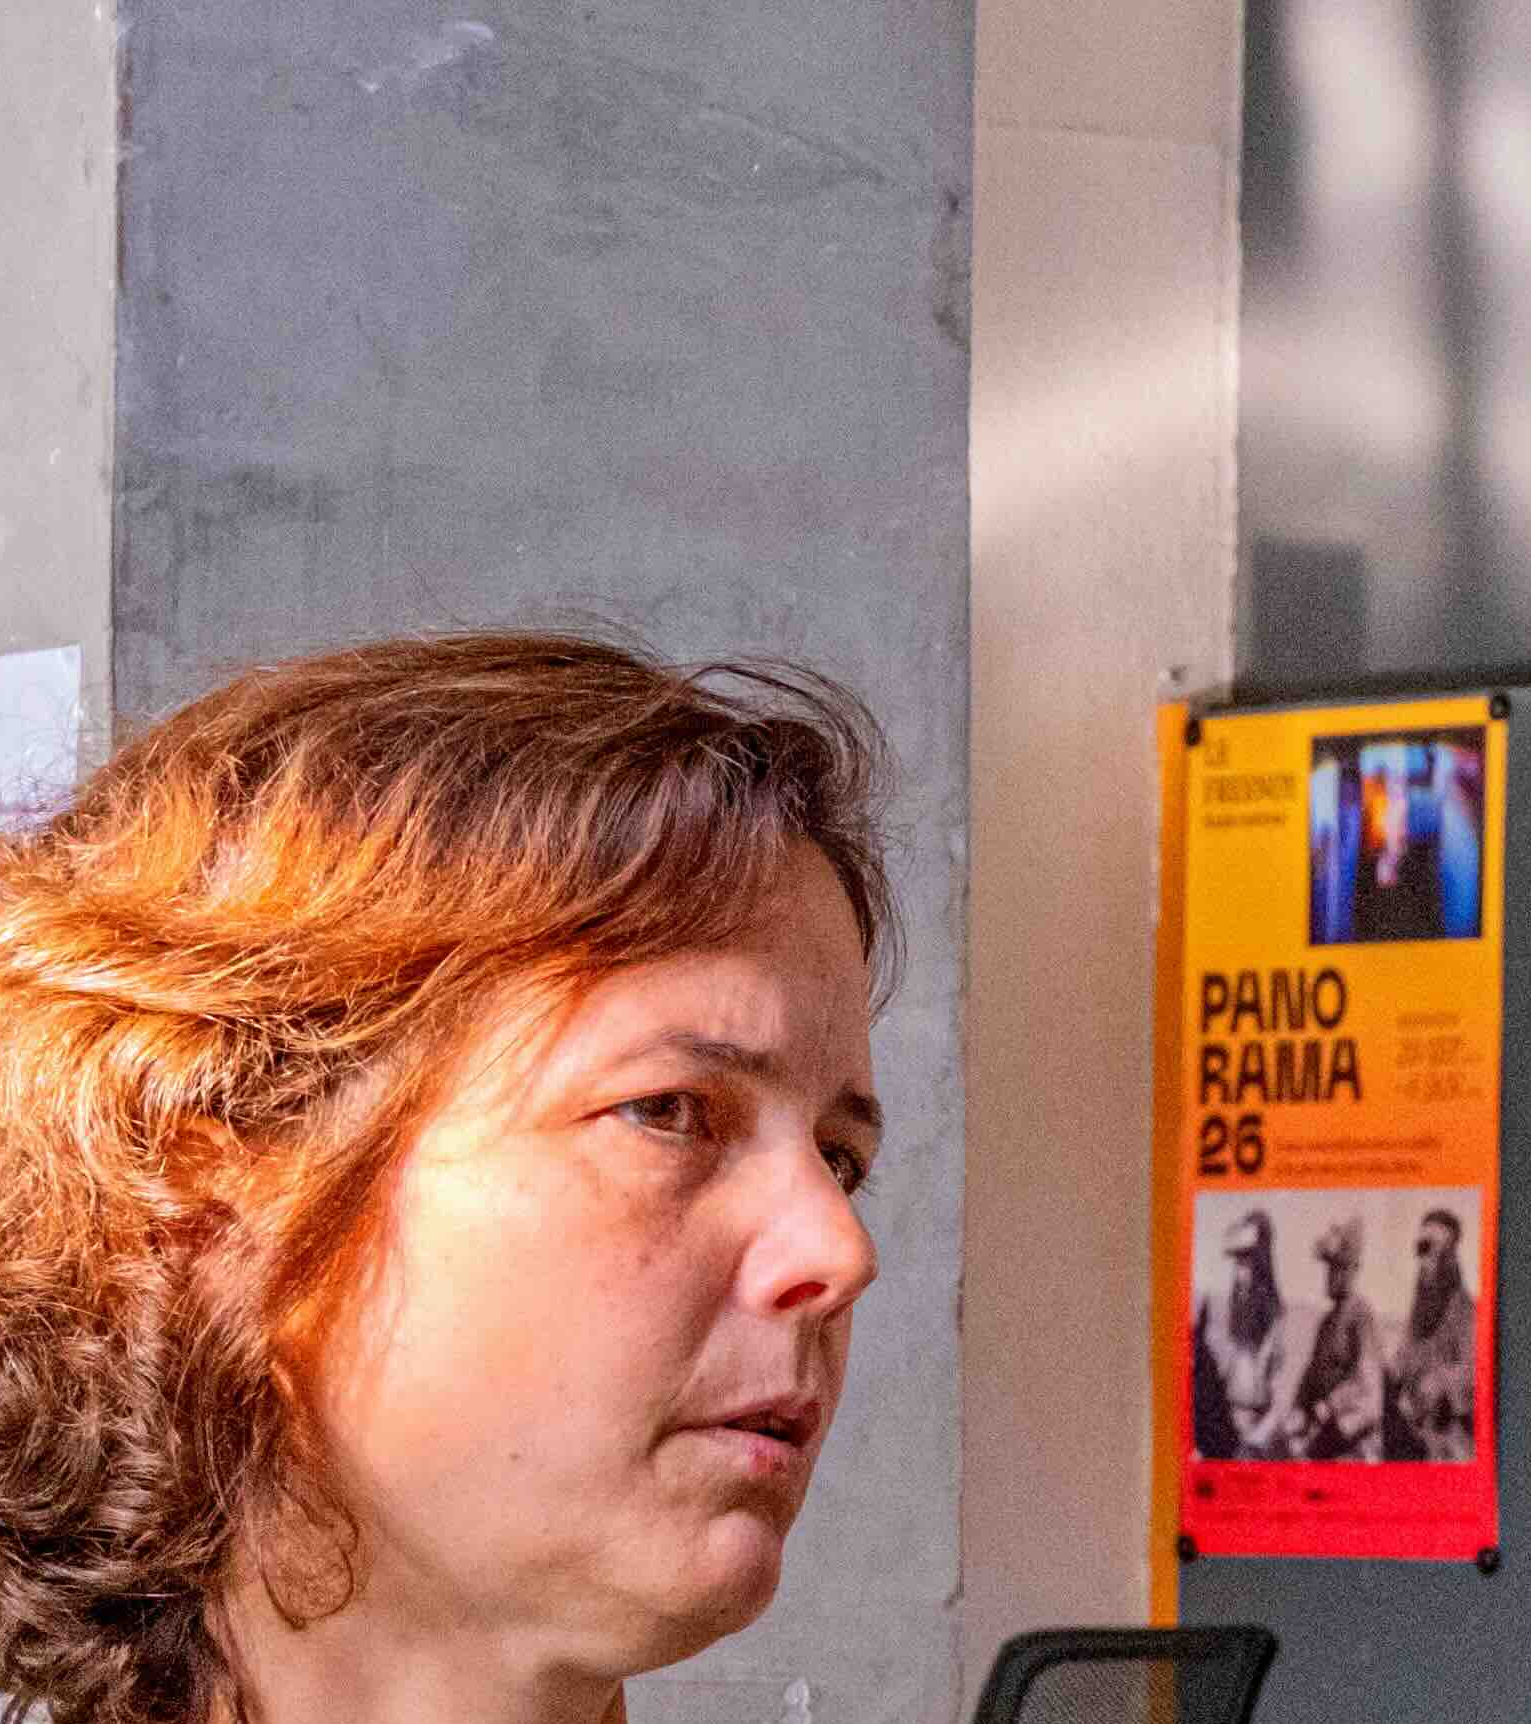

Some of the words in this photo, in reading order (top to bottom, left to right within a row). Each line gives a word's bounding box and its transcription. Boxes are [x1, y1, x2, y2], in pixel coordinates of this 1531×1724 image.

[1199, 967, 1347, 1033] PANO
[1199, 1038, 1363, 1105] RAMA
[1198, 1113, 1265, 1177] 26
